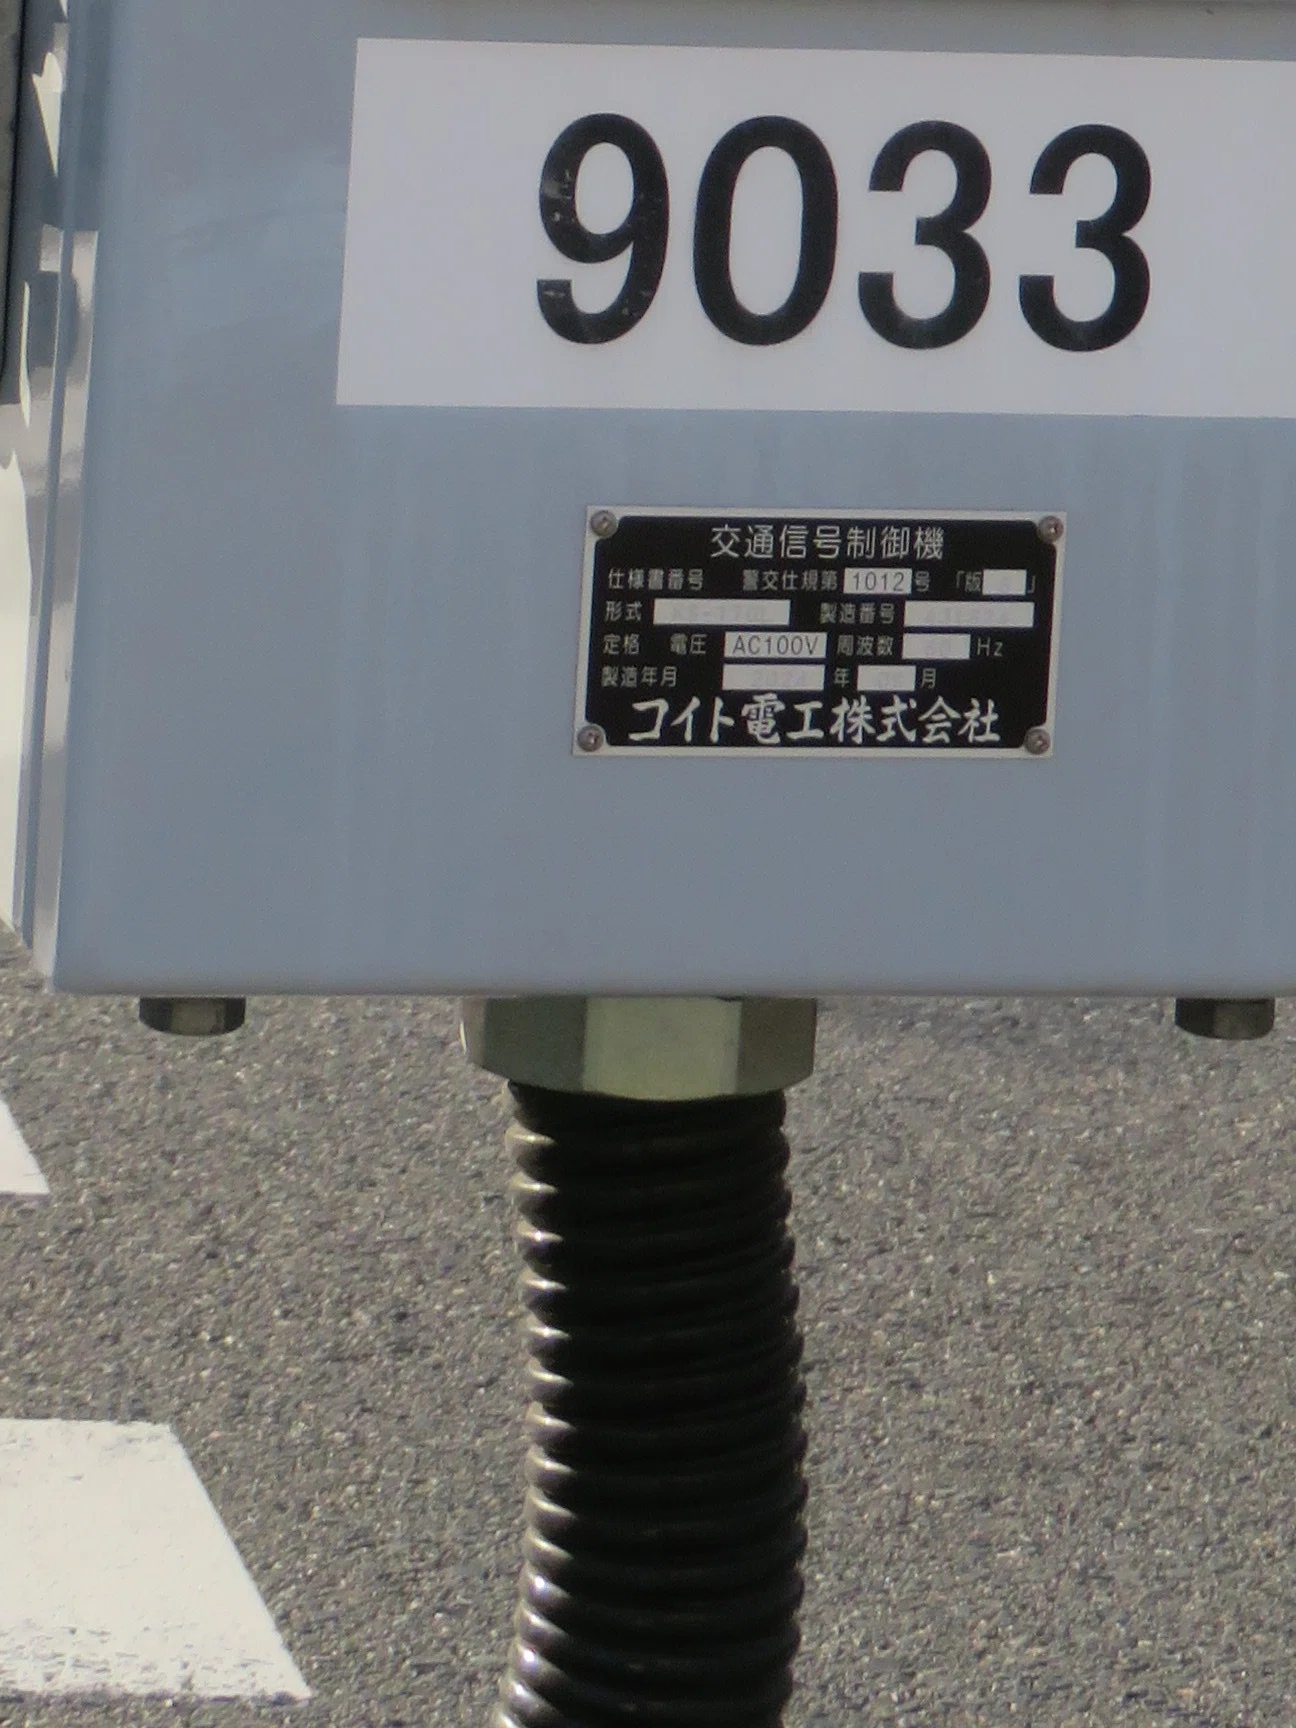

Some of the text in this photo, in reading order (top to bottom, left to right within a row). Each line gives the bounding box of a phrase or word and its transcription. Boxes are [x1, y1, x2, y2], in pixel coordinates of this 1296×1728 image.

[536, 112, 1152, 352] 9033
[709, 523, 945, 560] 交通信号制御機
[607, 567, 704, 591] 仕様書番号
[605, 600, 643, 623] 形式
[819, 602, 896, 625] 製造番号
[603, 632, 641, 656] 定格
[669, 633, 708, 656] 電圧
[732, 635, 819, 656] AC100V
[836, 634, 895, 657] 周波数
[976, 637, 1004, 658] Hz
[600, 666, 678, 689] 製造年月
[628, 692, 1001, 745] コイト電工株式会社
